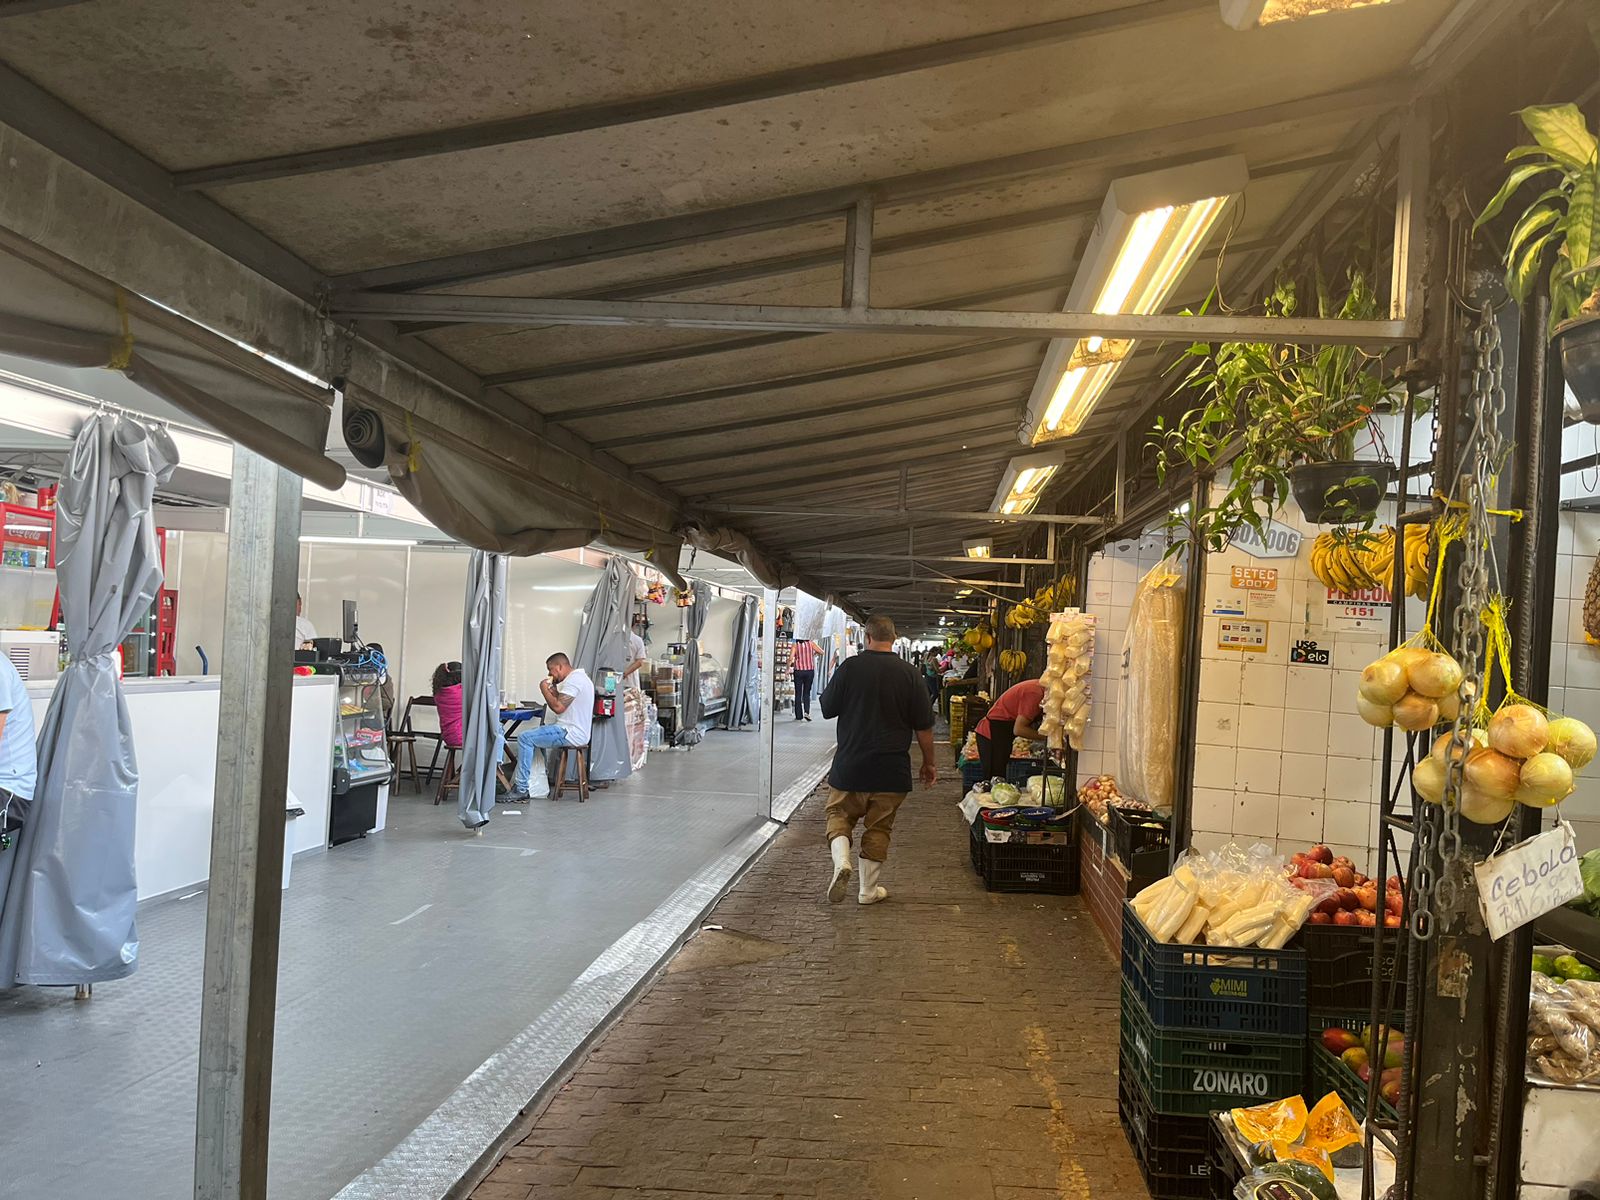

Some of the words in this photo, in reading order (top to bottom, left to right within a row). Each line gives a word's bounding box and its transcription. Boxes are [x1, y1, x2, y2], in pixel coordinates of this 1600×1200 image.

[1267, 529, 1299, 554] 006
[1234, 567, 1275, 580] SETEC
[1238, 579, 1270, 588] 2007
[1295, 640, 1318, 650] use
[1307, 651, 1328, 662] elo
[1219, 979, 1248, 992] MIMI
[1192, 1069, 1268, 1096] ZONARO
